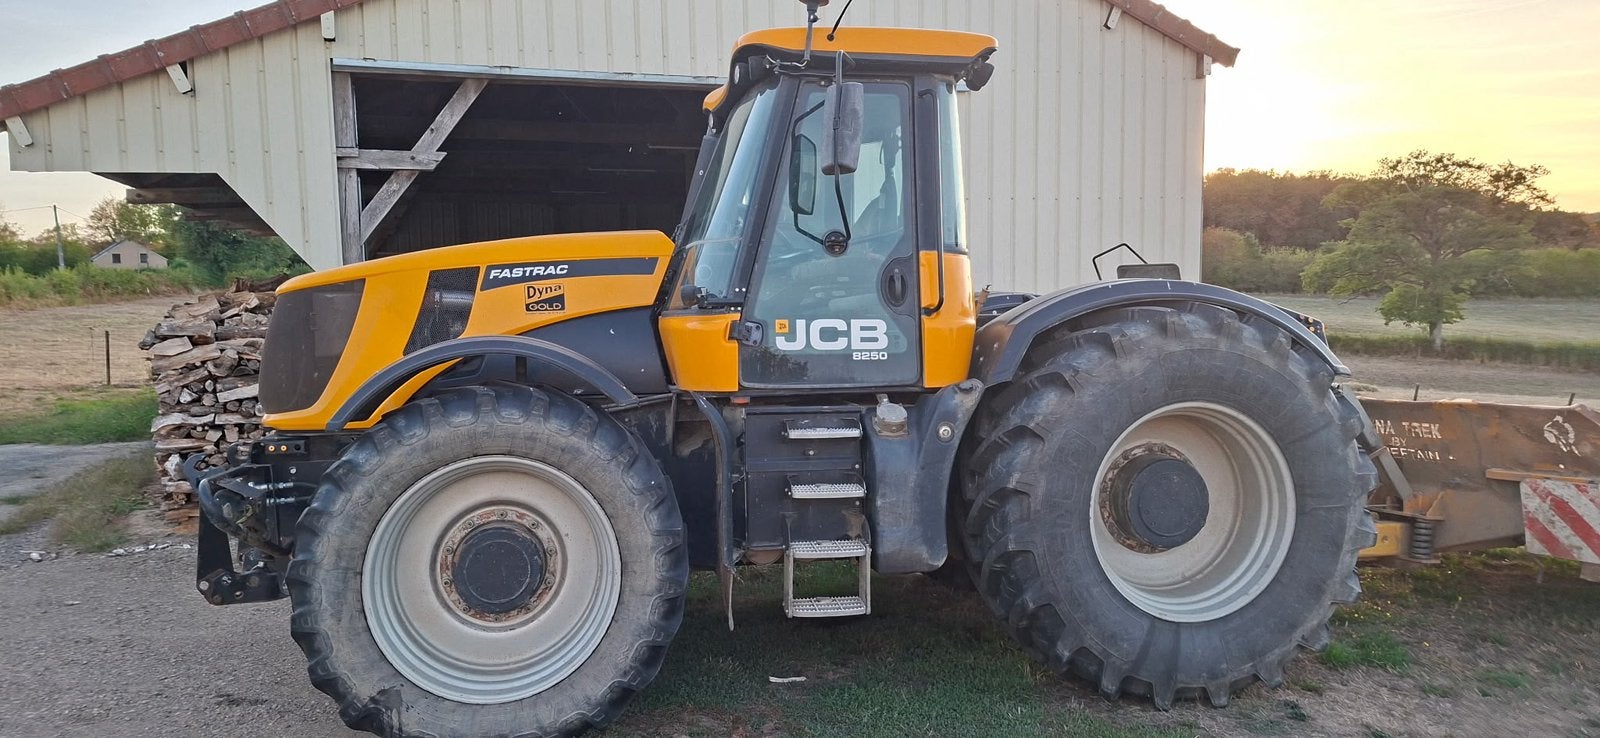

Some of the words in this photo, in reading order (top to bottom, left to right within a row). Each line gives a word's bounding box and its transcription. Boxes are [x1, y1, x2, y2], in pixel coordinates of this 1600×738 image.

[489, 265, 569, 279] FASTRAC
[527, 284, 562, 299] Dyna
[776, 319, 888, 350] JCB
[853, 352, 887, 360] 8250
[1373, 419, 1395, 434] NA
[1402, 421, 1442, 438] TREK
[1390, 437, 1407, 446] BY
